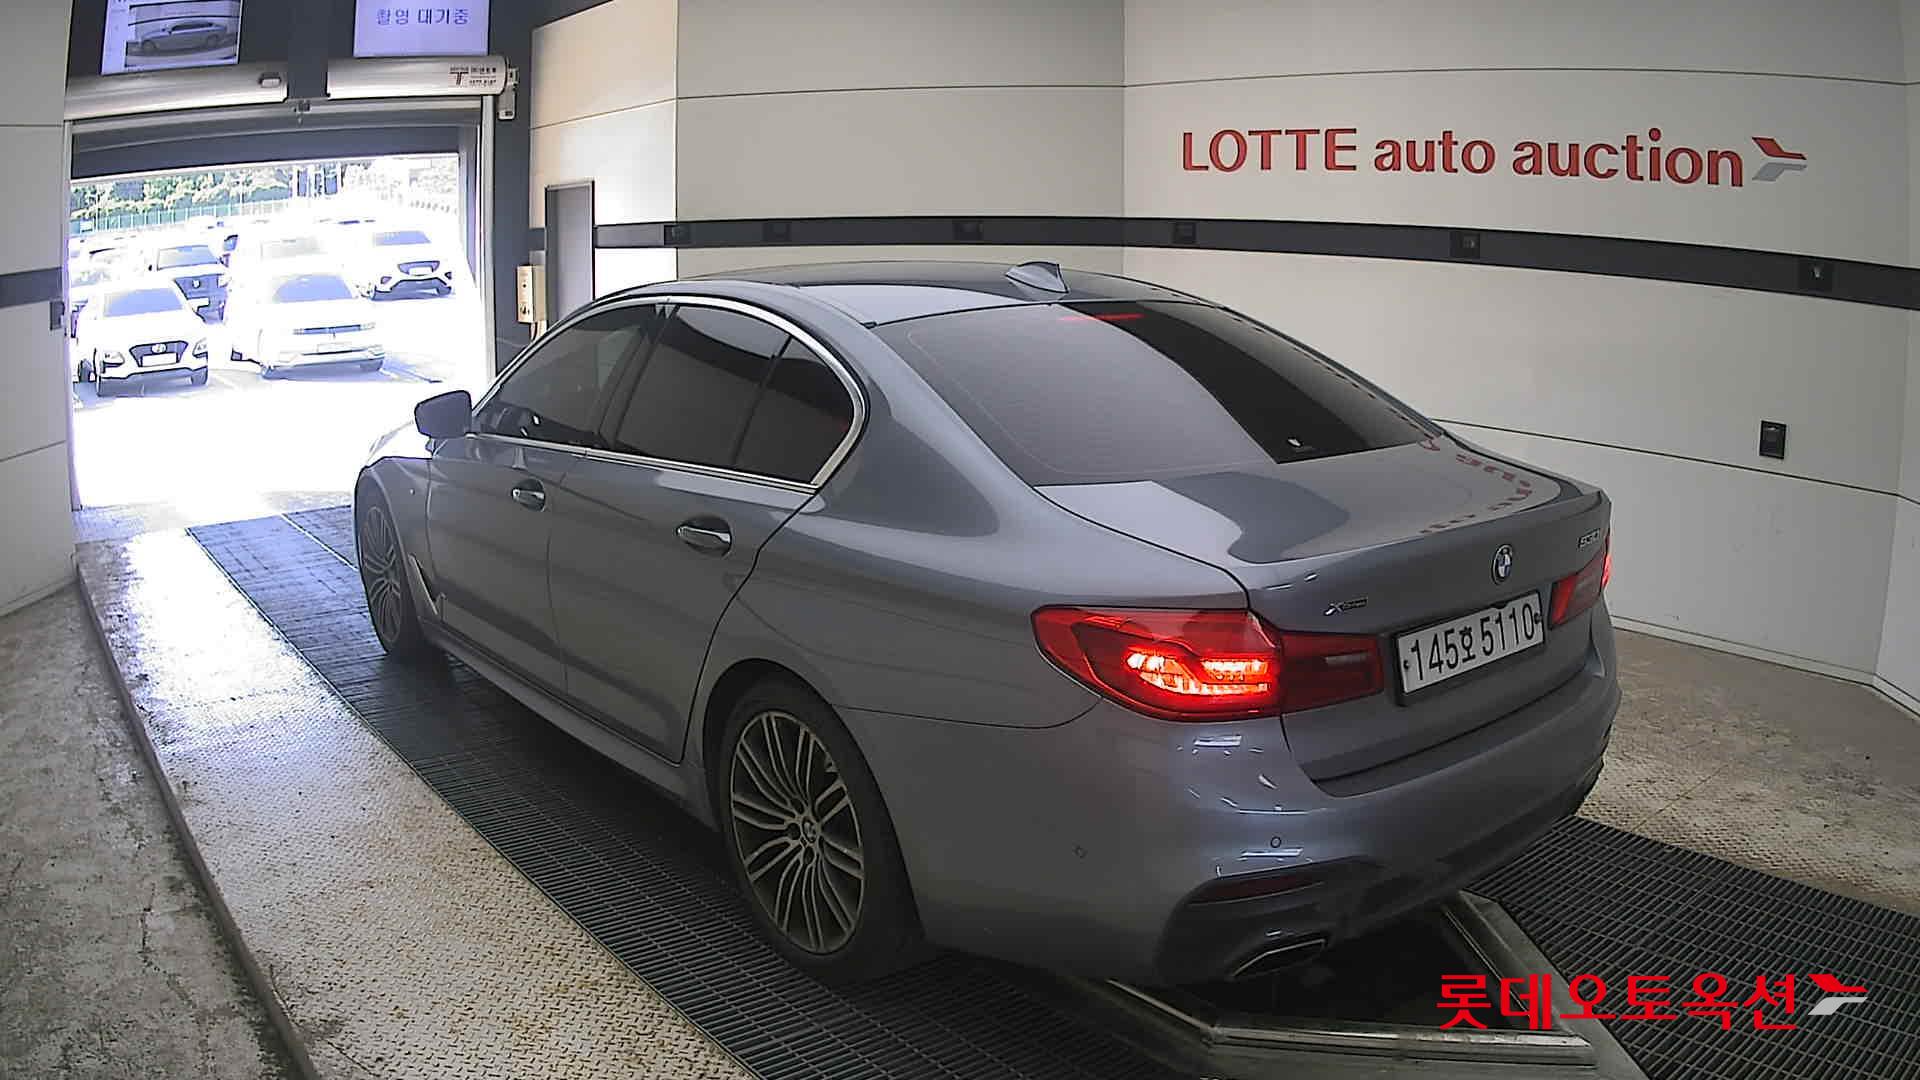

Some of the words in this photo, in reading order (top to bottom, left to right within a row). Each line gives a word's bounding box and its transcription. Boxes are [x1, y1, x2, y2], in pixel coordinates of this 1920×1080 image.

[418, 8, 468, 25] 대기중
[1183, 127, 1356, 172] LOTTE
[1374, 131, 1496, 174] auto
[1512, 127, 1743, 187] auction
